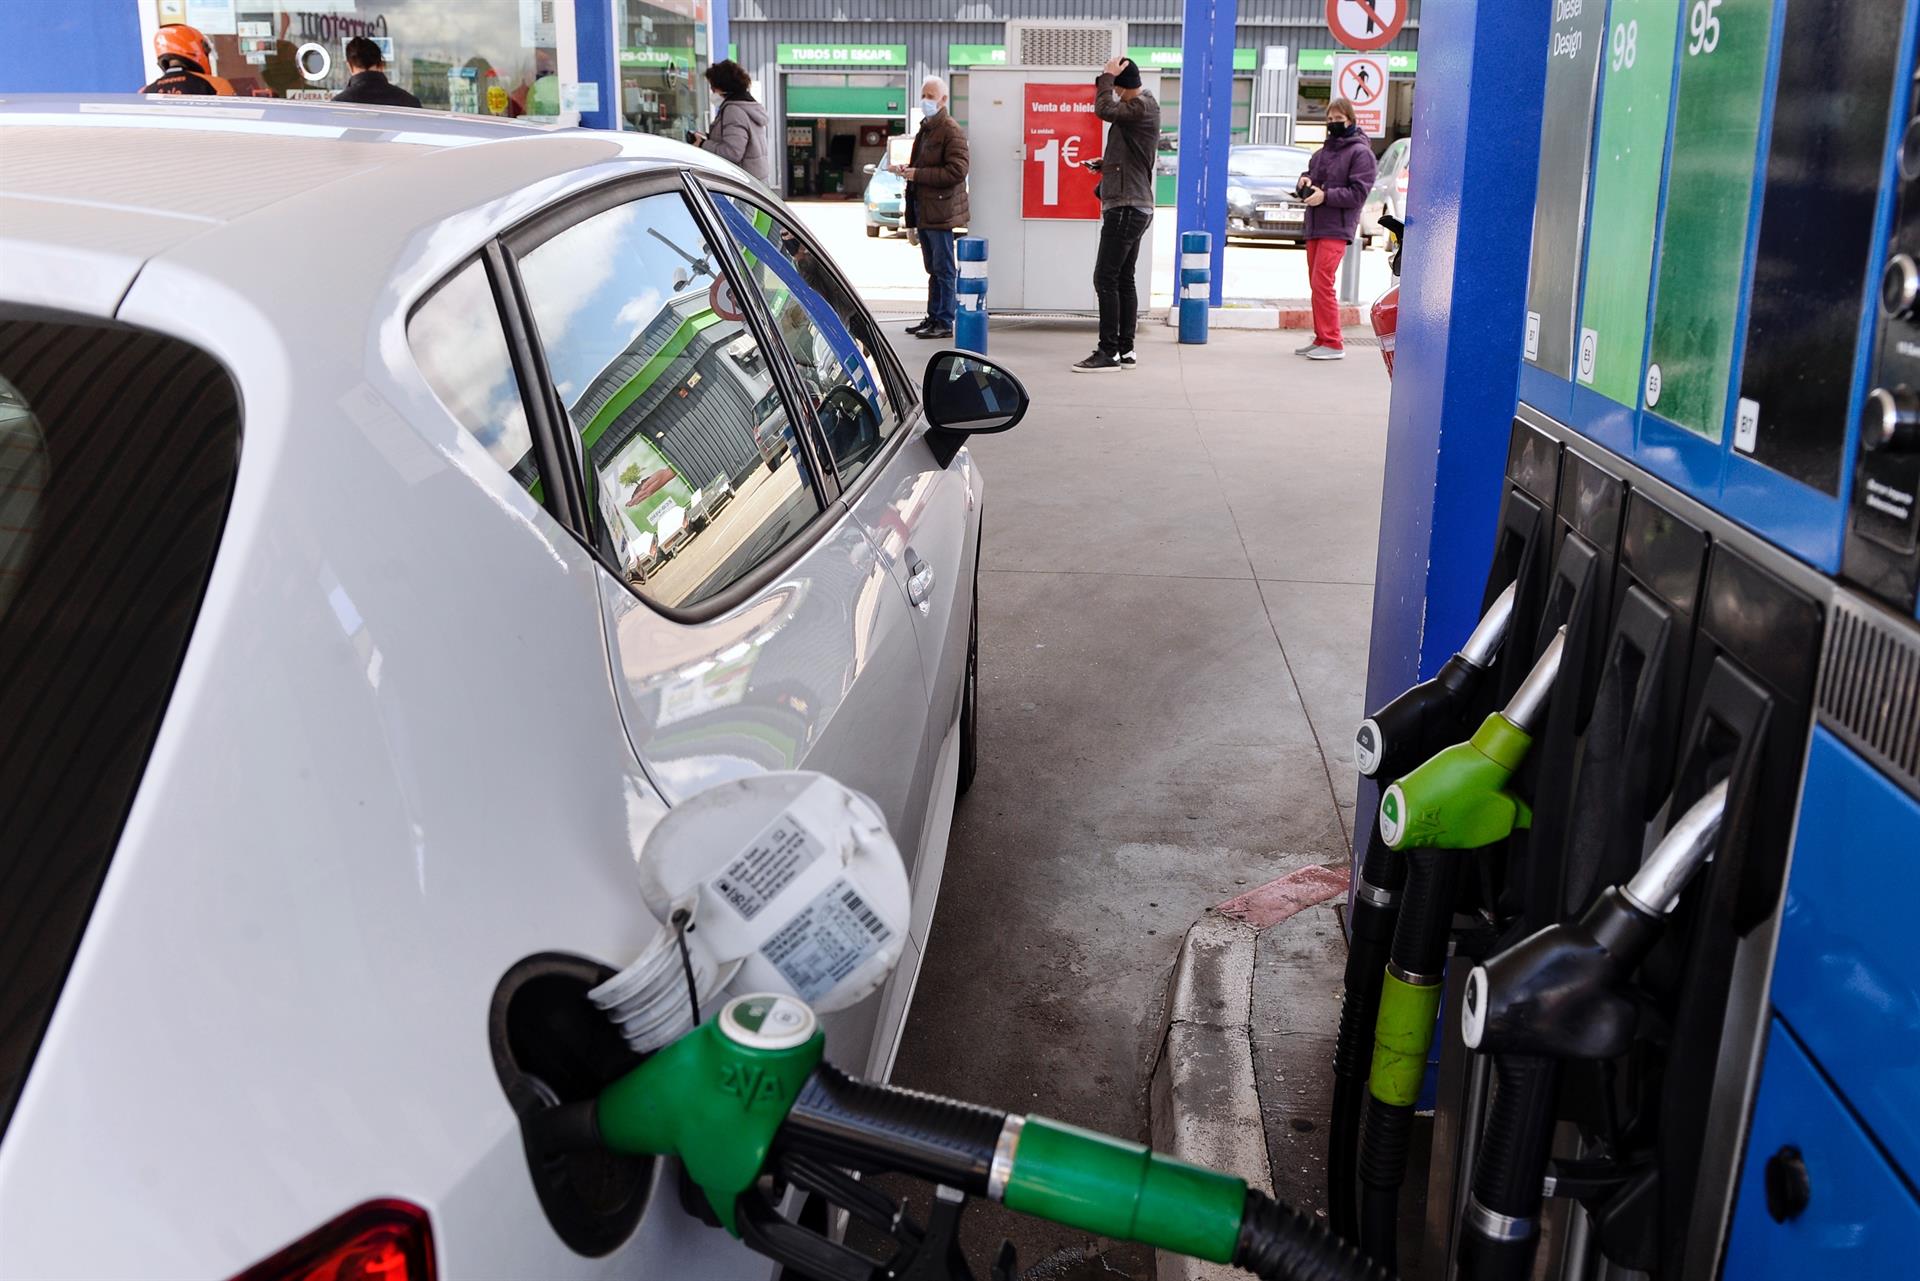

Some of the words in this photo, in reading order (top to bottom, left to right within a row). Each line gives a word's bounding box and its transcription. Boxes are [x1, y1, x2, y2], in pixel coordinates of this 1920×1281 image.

[1556, 0, 1583, 22] Diesel
[1689, 0, 1722, 56] 95
[792, 49, 831, 60] TUBOS
[832, 49, 848, 60] DE
[850, 49, 892, 60] ESCAPE
[1553, 27, 1583, 59] Design
[1612, 19, 1638, 73] 98
[1032, 102, 1058, 112] Venta
[1060, 102, 1071, 112] de
[1073, 102, 1095, 113] hielo
